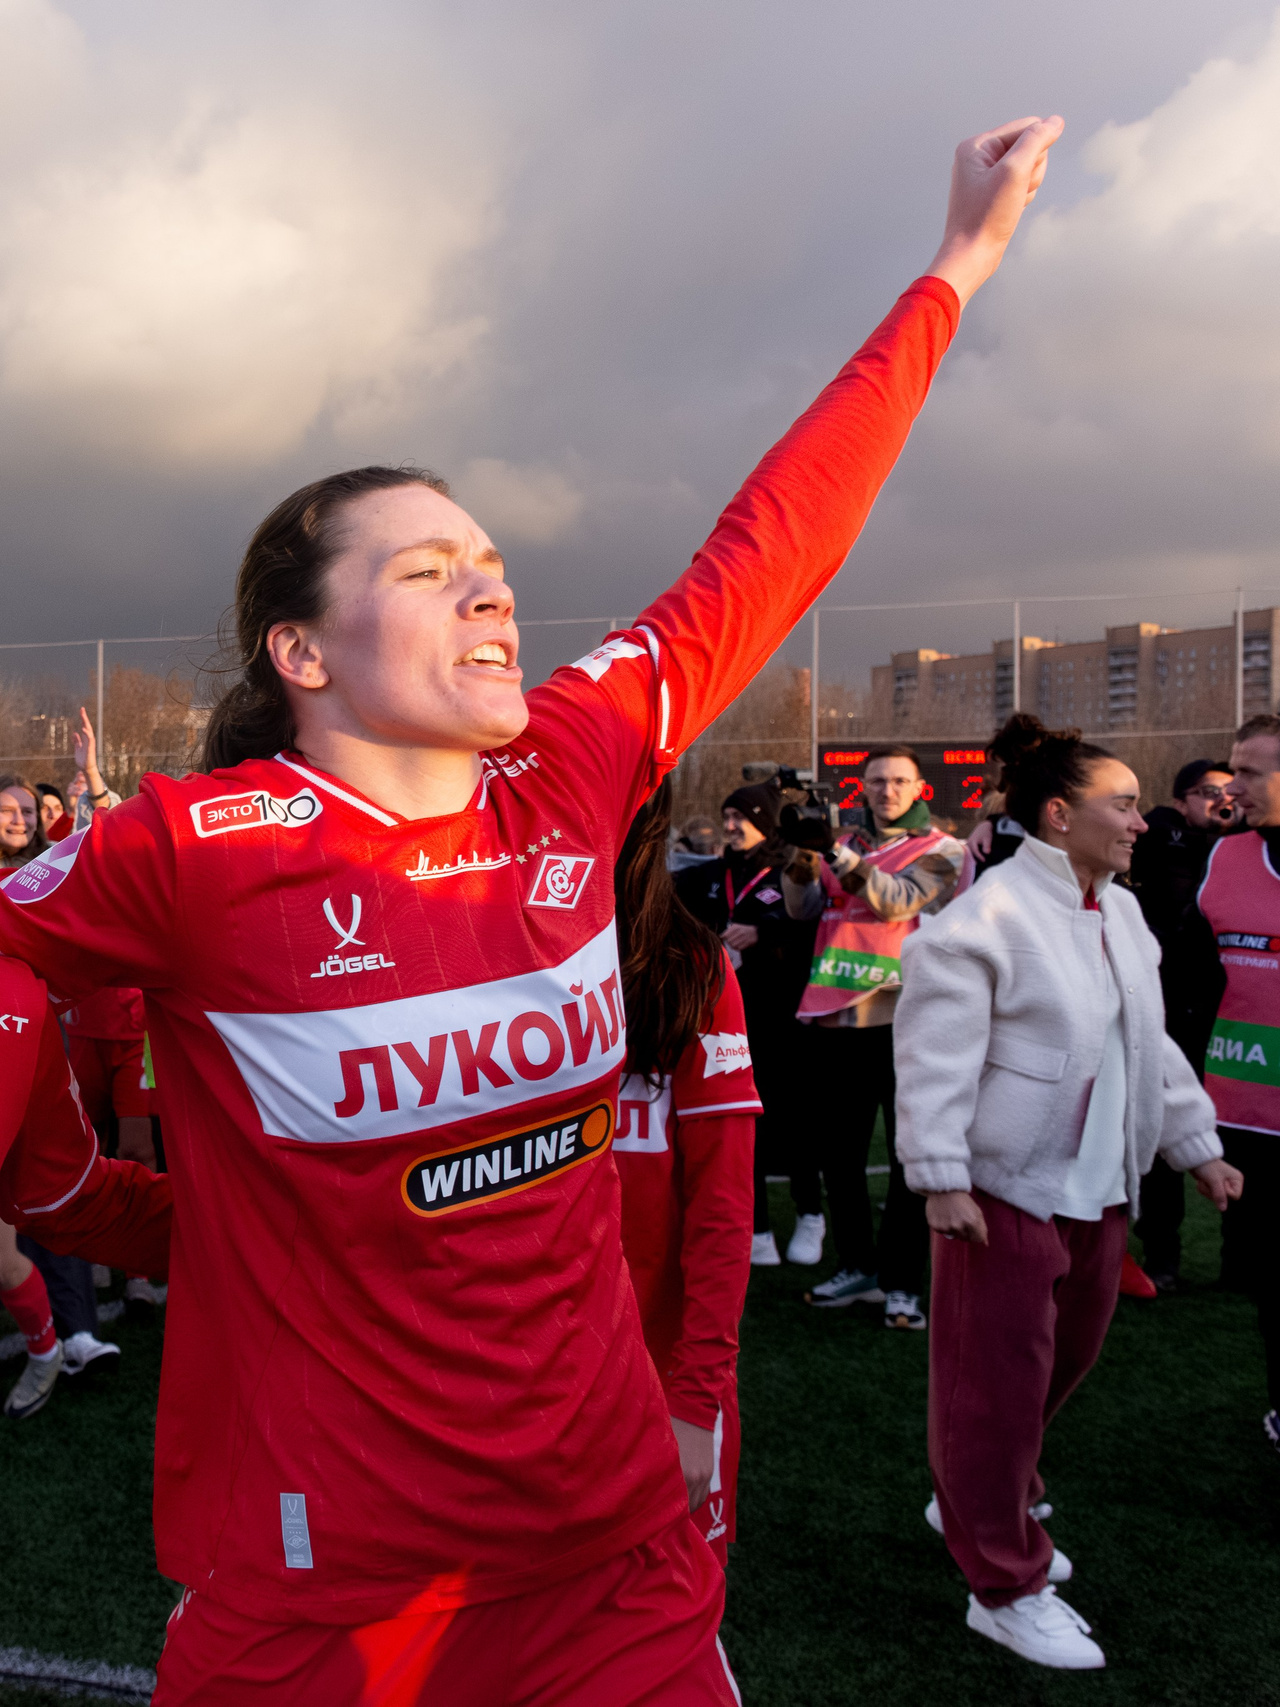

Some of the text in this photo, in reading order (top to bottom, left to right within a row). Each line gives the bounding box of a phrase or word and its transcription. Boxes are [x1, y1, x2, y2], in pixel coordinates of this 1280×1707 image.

[16, 873, 41, 892] ЛИГА
[310, 953, 396, 979] JÖGEL
[819, 959, 901, 985] КЛУБА
[333, 968, 626, 1119] ЛУКОЙЛ
[1207, 1036, 1268, 1067] ДИА
[420, 1121, 579, 1204] WINLINE
